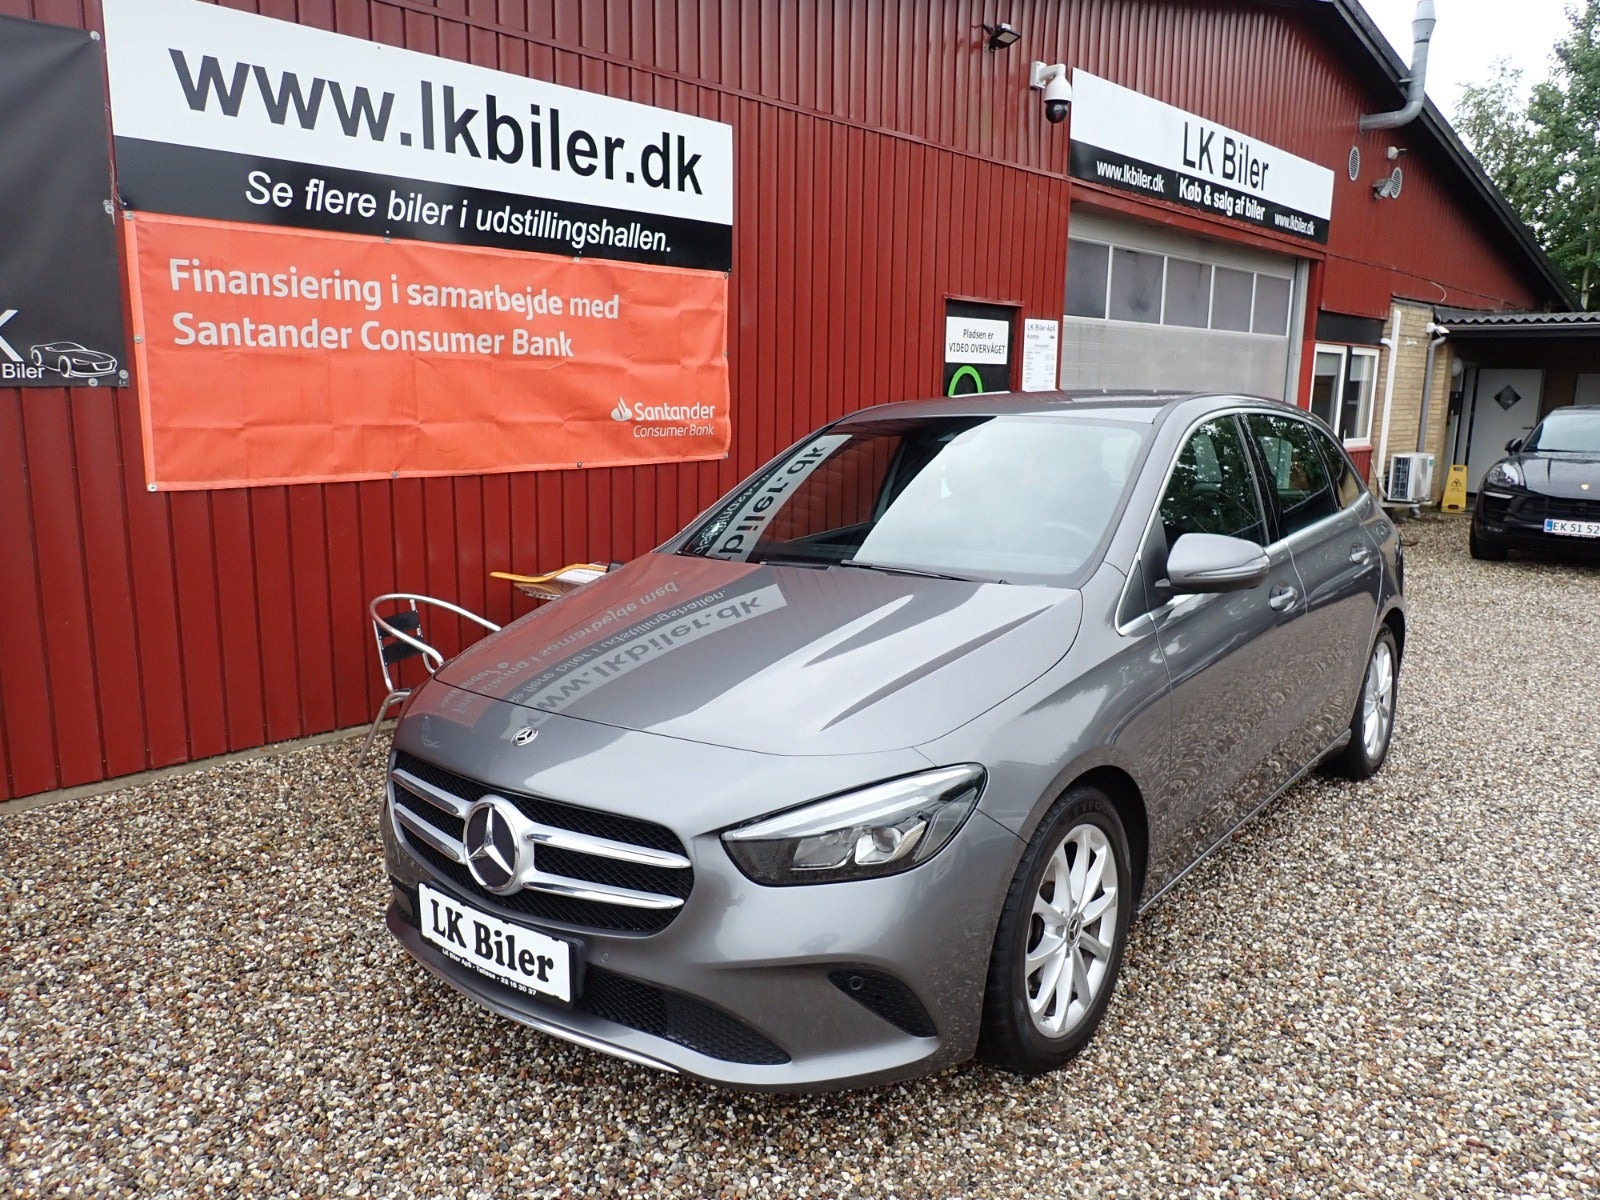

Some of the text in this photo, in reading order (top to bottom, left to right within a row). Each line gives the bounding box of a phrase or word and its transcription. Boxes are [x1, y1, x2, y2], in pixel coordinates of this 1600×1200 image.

[168, 48, 702, 195] www.lkbiler.dk
[1182, 121, 1269, 191] LK Biler
[1096, 160, 1164, 193] www.lkbiler.dk
[245, 170, 671, 252] Se flere biler i udstillingshallen.
[1179, 177, 1265, 221] Køb & salg af biler
[1274, 212, 1315, 236] www.lkbiler.dk
[169, 258, 619, 321] Finansiering i samarbejde med
[172, 312, 575, 357] Santander Consumer Bank
[949, 342, 1006, 355] VIDEO OVERVÅGET
[963, 328, 995, 340] Pladsen er
[2, 363, 45, 379] Biler
[634, 402, 716, 421] Santander
[633, 423, 714, 438] Consumer Bank
[1552, 522, 1600, 534] EK 51 52
[430, 899, 554, 982] LK Biler
